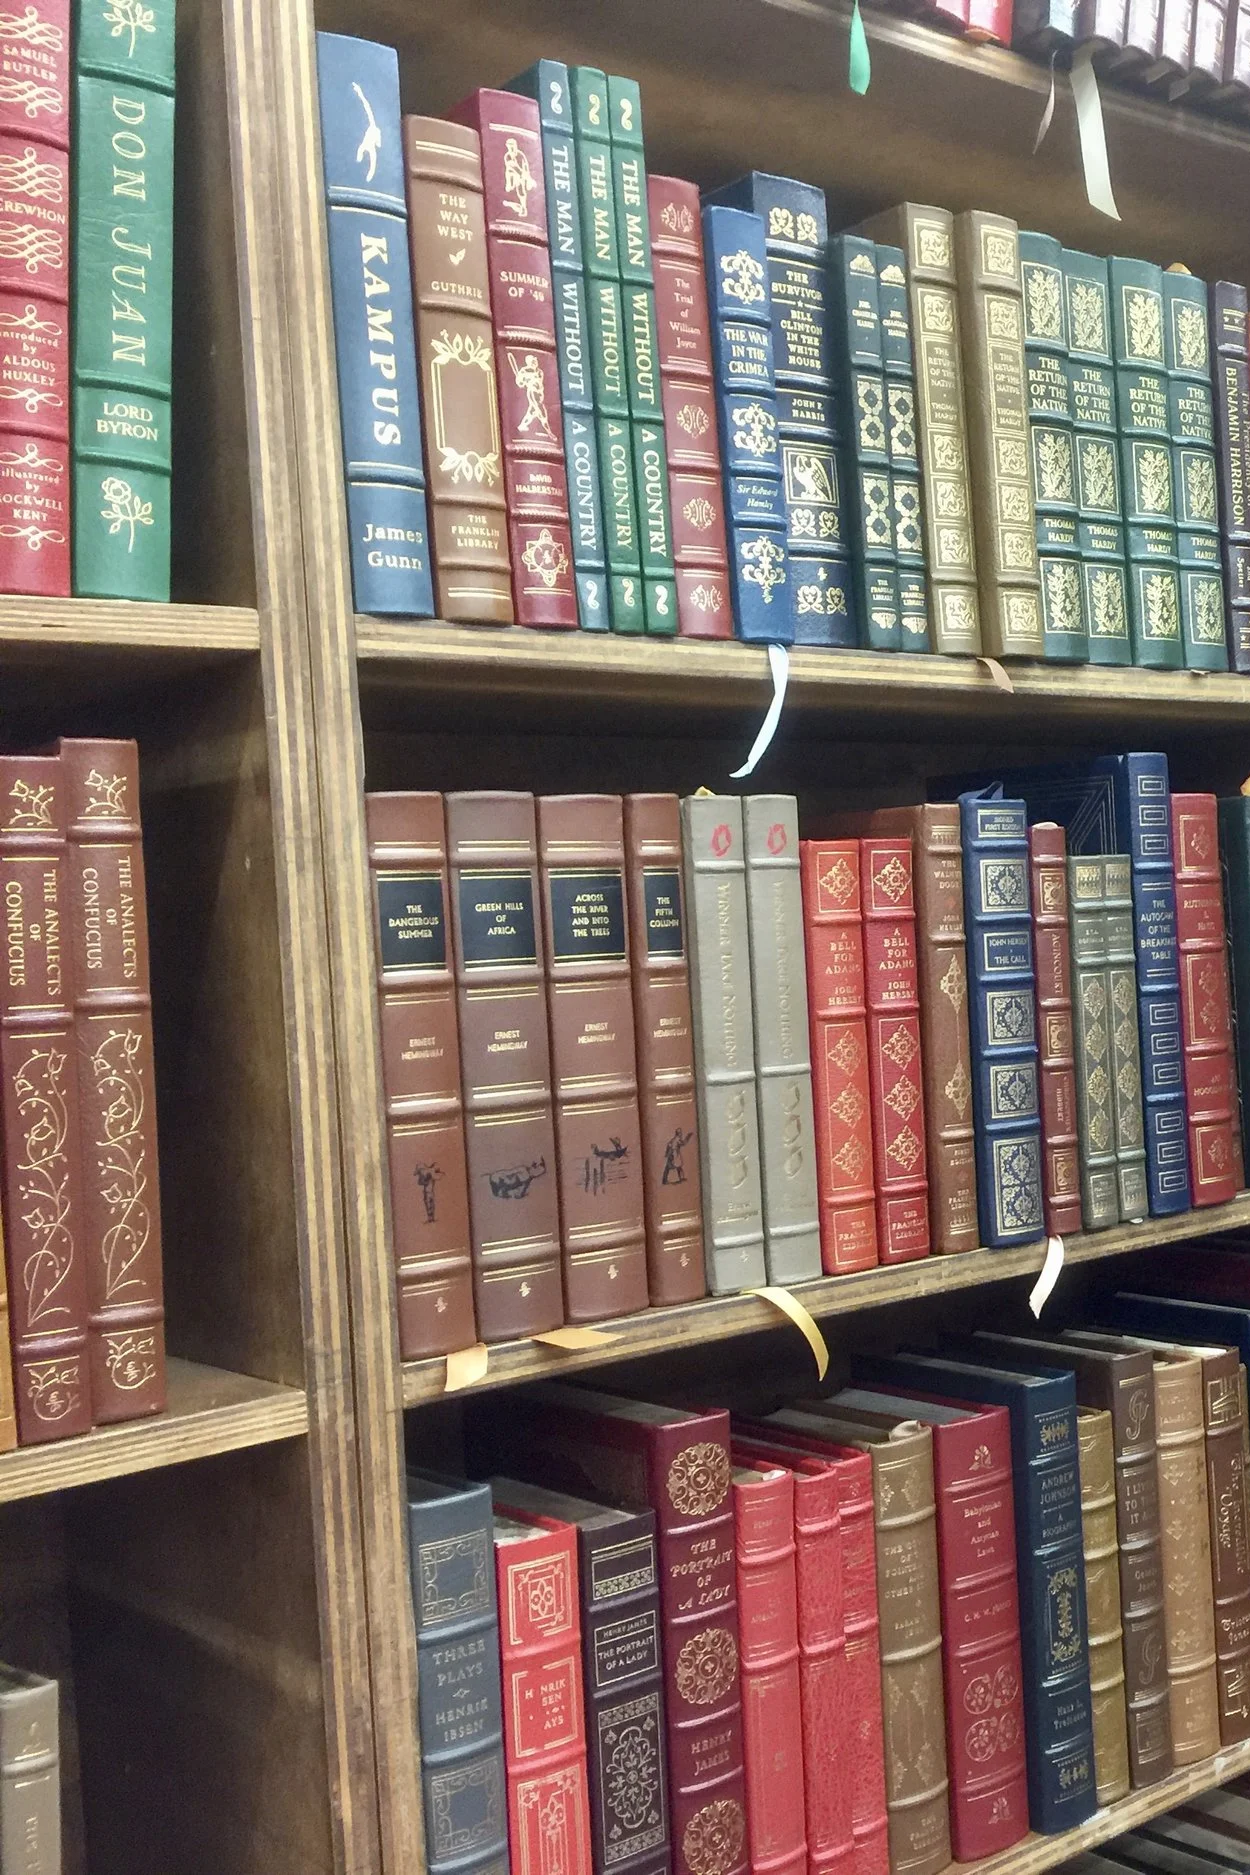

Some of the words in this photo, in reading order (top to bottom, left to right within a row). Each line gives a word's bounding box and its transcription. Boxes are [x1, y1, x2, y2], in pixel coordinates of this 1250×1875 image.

[3, 43, 57, 68] SAMUEL
[3, 60, 57, 83] BUTLER
[112, 94, 147, 202] DON
[550, 146, 572, 194] THE
[589, 155, 607, 201] THE
[621, 160, 640, 208] THE
[438, 193, 467, 209] THE
[440, 209, 469, 226] WAY
[437, 224, 473, 243] WEST
[557, 200, 575, 256] MAN
[593, 206, 611, 262] MAN
[627, 212, 645, 268] MAN
[499, 271, 549, 289] SUMMER
[786, 270, 809, 284] THE
[112, 226, 153, 368] JUAN
[431, 280, 483, 299] GUTHRIE
[771, 281, 822, 302] SURVIVOR
[790, 308, 813, 322] BILL
[780, 318, 823, 336] CLINTON
[359, 232, 401, 447] KAMPUS
[562, 281, 587, 397] WITHOUT
[599, 286, 621, 398] WITHOUT
[724, 328, 746, 345] THE
[747, 331, 769, 347] WAR
[786, 331, 799, 343] IN
[800, 332, 820, 347] THE
[22, 342, 37, 355] by
[632, 291, 656, 406] WITHOUT
[731, 345, 745, 358] IN
[746, 347, 767, 363] THE
[787, 342, 820, 358] WHITE
[3, 354, 56, 372] ALDOUS
[729, 360, 770, 379] CRIMEA
[788, 355, 821, 371] HOUSE
[1038, 356, 1060, 371] THE
[3, 370, 56, 387] HUXLEY
[1029, 369, 1068, 387] RETURN
[1082, 369, 1102, 382] THE
[1139, 376, 1160, 390] THE
[1030, 383, 1046, 396] OF
[1049, 385, 1067, 400] THE
[1073, 380, 1111, 397] RETURN
[1129, 388, 1166, 405] RETURN
[1187, 386, 1206, 400] THE
[102, 400, 154, 422] LORD
[1032, 397, 1068, 414] NATIVE
[1075, 395, 1090, 408] OF
[1092, 397, 1110, 410] THE
[1131, 402, 1146, 414] OF
[1148, 404, 1166, 418] THE
[1226, 366, 1240, 442] BENJAMIN
[792, 408, 825, 422] HARRIS
[1076, 408, 1111, 424] NATIVE
[1133, 415, 1167, 431] NATIVE
[96, 418, 159, 442] BYRON
[571, 420, 588, 437] A
[608, 422, 623, 439] A
[641, 428, 659, 444] A
[25, 480, 40, 493] by
[1230, 446, 1245, 527] HARRISON
[572, 442, 597, 552] COUNTRY
[609, 444, 633, 552] COUNTRY
[642, 449, 668, 560] COUNTRY
[13, 508, 48, 522] KENT
[467, 513, 488, 525] THE
[364, 522, 423, 546] James
[1048, 531, 1074, 543] HARDY
[1092, 539, 1116, 551] HARDY
[1147, 543, 1171, 555] HARDY
[367, 548, 423, 572] Gunn
[1194, 550, 1217, 561] HARDY
[118, 855, 132, 888] THE
[43, 869, 57, 903] THE
[575, 893, 604, 903] ACROSS
[656, 896, 671, 905] THE
[1152, 898, 1166, 908] THE
[405, 904, 422, 914] THE
[475, 903, 502, 912] GREEN
[504, 902, 524, 911] HILLS
[571, 905, 588, 914] THE
[82, 867, 103, 970] CONFUCIUS
[106, 908, 118, 926] OF
[388, 916, 439, 927] DANGEROUS
[495, 914, 507, 923] OF
[572, 916, 590, 926] AND
[592, 915, 609, 924] INTO
[5, 881, 26, 986] CONFUCIUS
[29, 923, 41, 942] OF
[120, 893, 137, 979] ANALECTS
[398, 929, 433, 940] SUMMER
[487, 926, 516, 936] AFRICA
[572, 928, 588, 937] THE
[894, 928, 901, 936] A
[1148, 925, 1159, 935] OF
[829, 941, 857, 951] BELL
[883, 938, 910, 947] BELL
[45, 908, 61, 996] ANALECTS
[887, 949, 908, 958] FOR
[1151, 951, 1171, 960] TABLE
[1219, 1487, 1233, 1549] Voyage
[690, 1538, 717, 1555] THE
[696, 1575, 712, 1588] OF
[678, 1597, 693, 1610] A
[698, 1584, 731, 1606] LADY
[432, 1639, 486, 1665] THREE
[598, 1646, 615, 1660] THE
[615, 1634, 654, 1657] PORTRAIT
[605, 1659, 618, 1670] OF
[618, 1658, 626, 1667] A
[625, 1649, 648, 1664] LADY
[436, 1662, 484, 1687] PLAYS
[444, 1719, 484, 1742] IBSEN
[690, 1729, 732, 1755] HENRY
